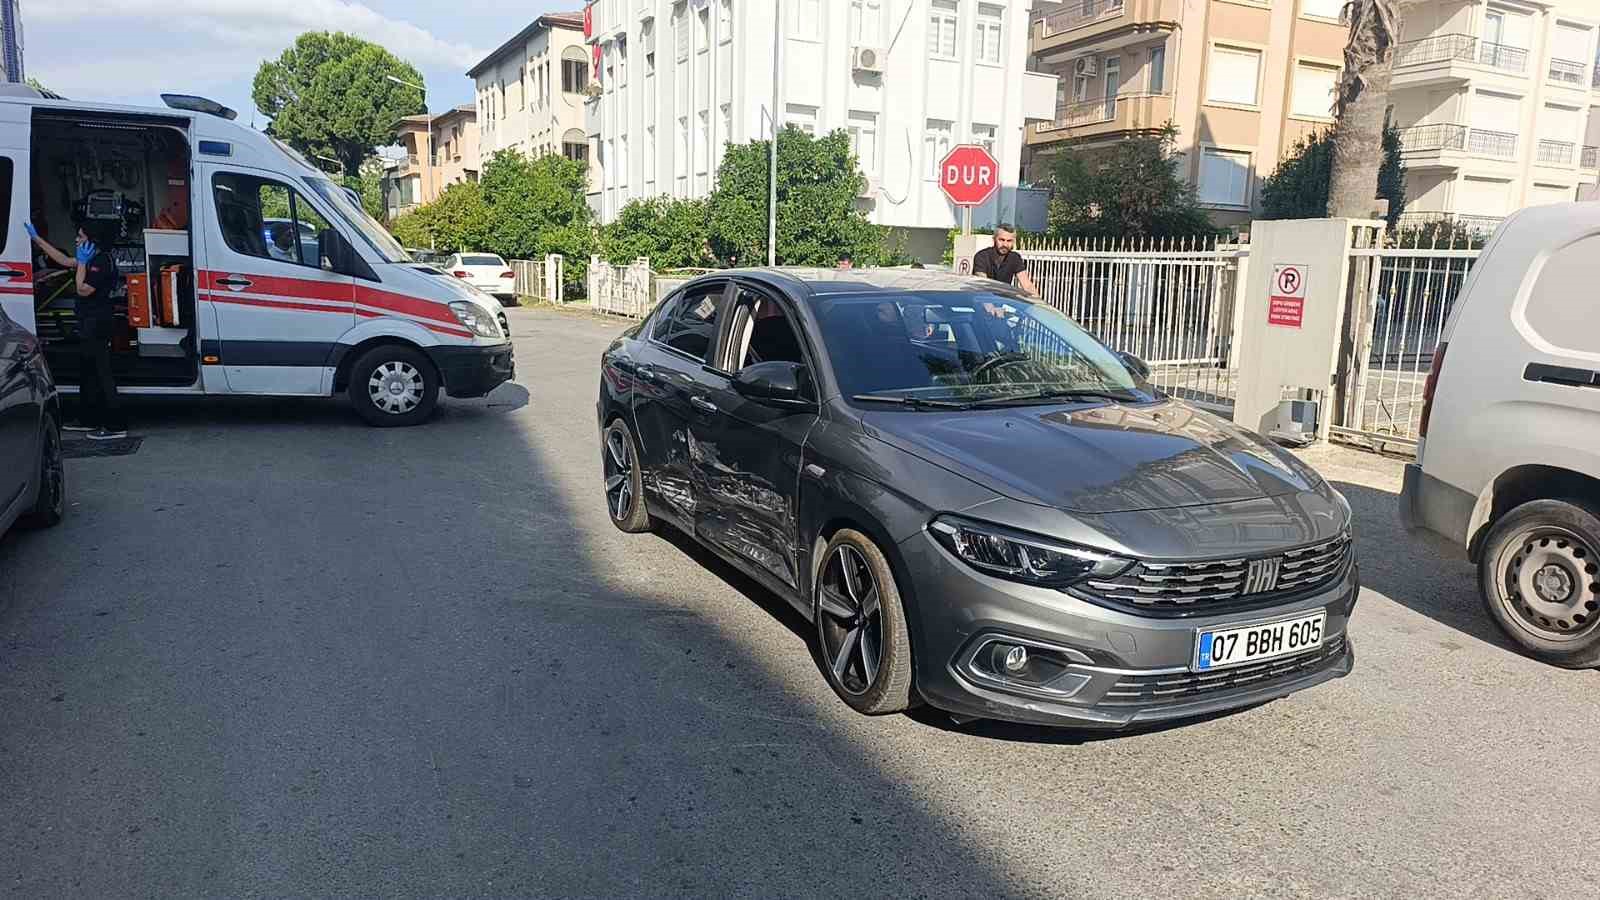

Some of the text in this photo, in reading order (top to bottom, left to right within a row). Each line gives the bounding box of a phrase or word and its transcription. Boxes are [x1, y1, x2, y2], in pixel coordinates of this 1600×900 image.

[947, 165, 991, 186] DUR
[1242, 557, 1283, 595] FIAT
[1212, 618, 1321, 662] 07 BBH 605
